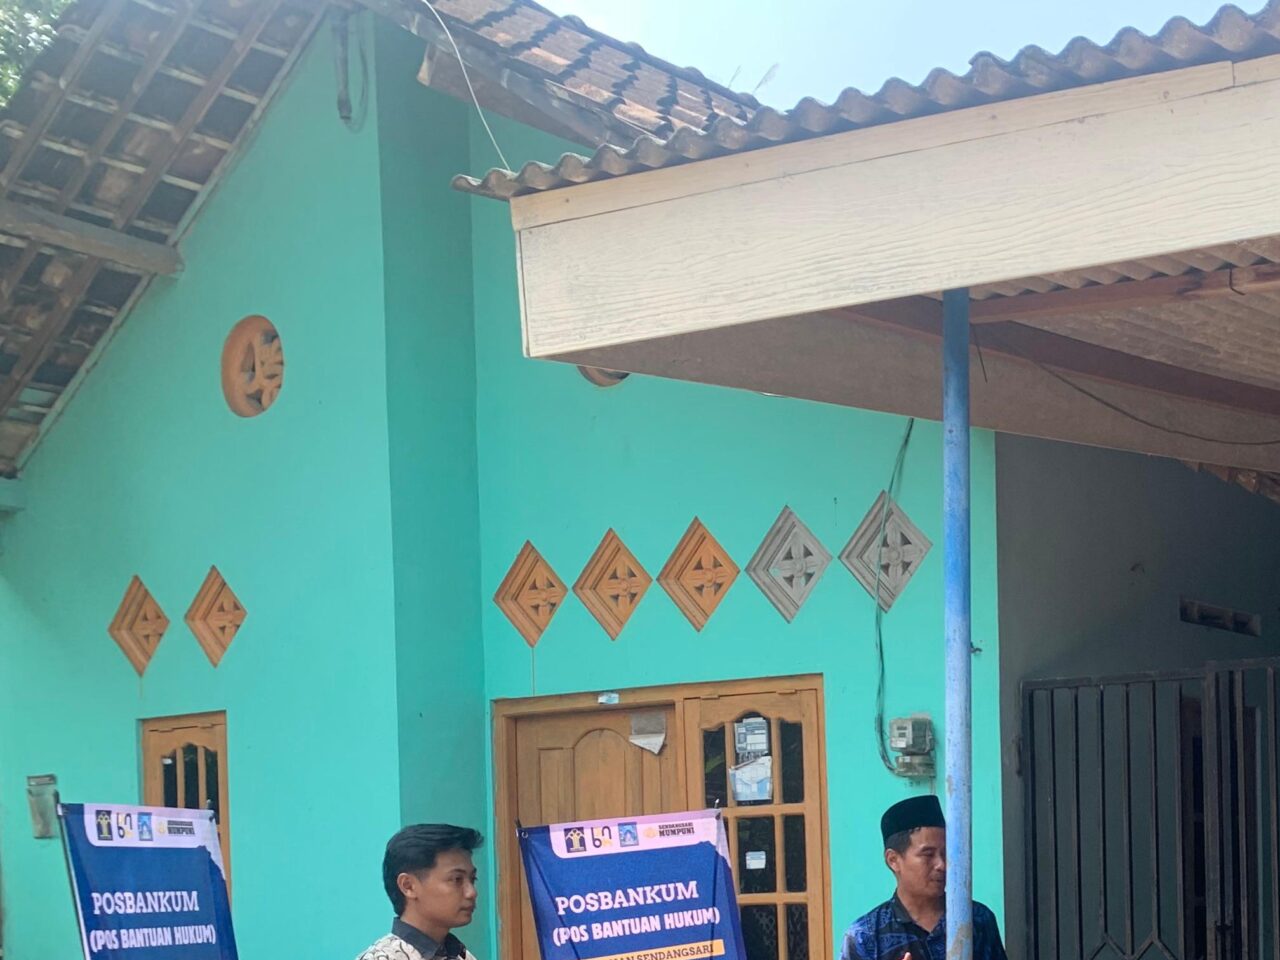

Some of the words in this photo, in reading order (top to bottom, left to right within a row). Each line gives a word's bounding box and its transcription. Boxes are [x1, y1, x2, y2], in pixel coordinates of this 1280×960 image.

[658, 827, 695, 837] MUMPUNI
[91, 890, 200, 915] POSBANKUM
[555, 880, 699, 915] POSBANKUM
[89, 929, 119, 953] (POS
[120, 926, 172, 949] BANTUAN
[173, 924, 216, 945] HUKUM)
[552, 924, 590, 947] (POS
[591, 915, 661, 940] BANTUAN
[664, 907, 721, 930] HUKUM)
